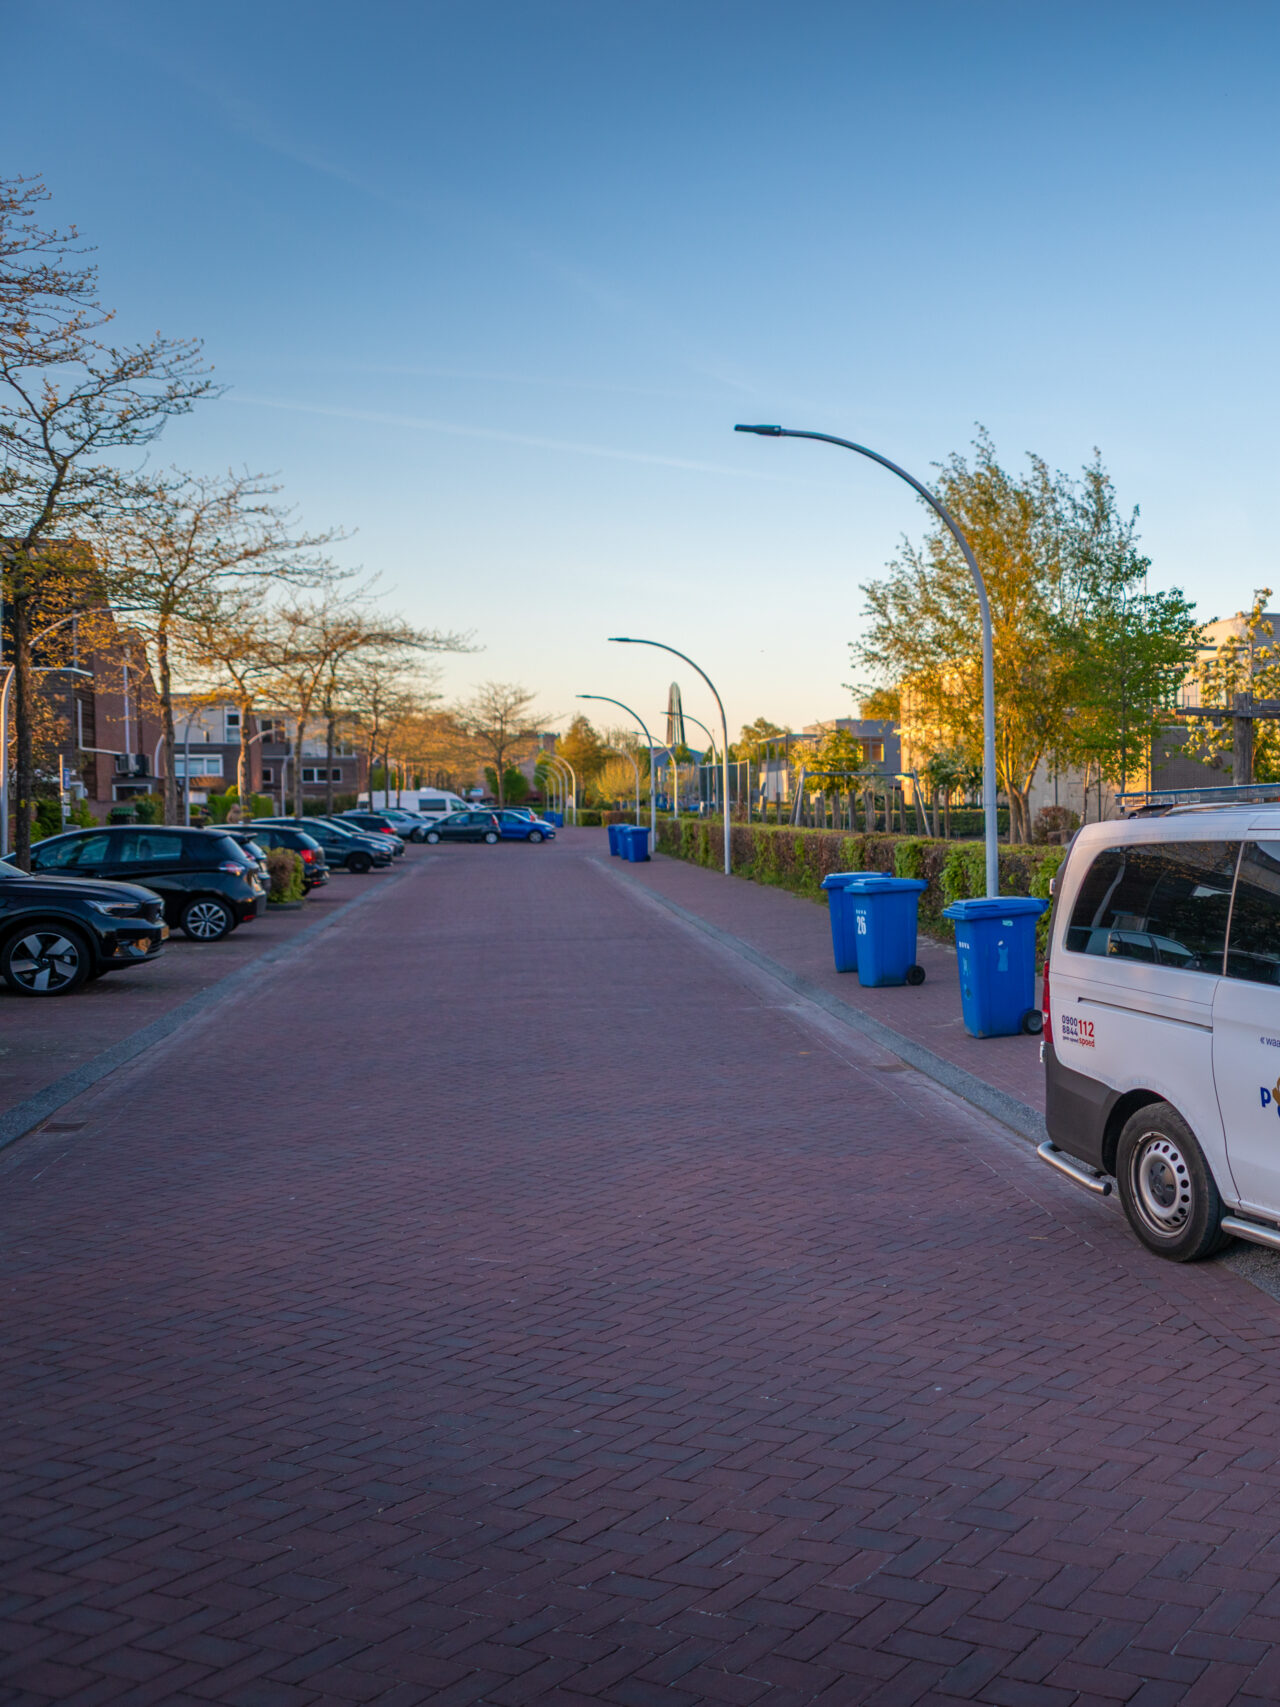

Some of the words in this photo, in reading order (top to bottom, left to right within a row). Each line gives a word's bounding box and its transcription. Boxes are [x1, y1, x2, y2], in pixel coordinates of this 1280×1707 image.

[856, 915, 867, 935] 26
[1061, 1014, 1078, 1027] 0900
[1078, 1019, 1095, 1038] 112
[1062, 1025, 1078, 1036] 8844
